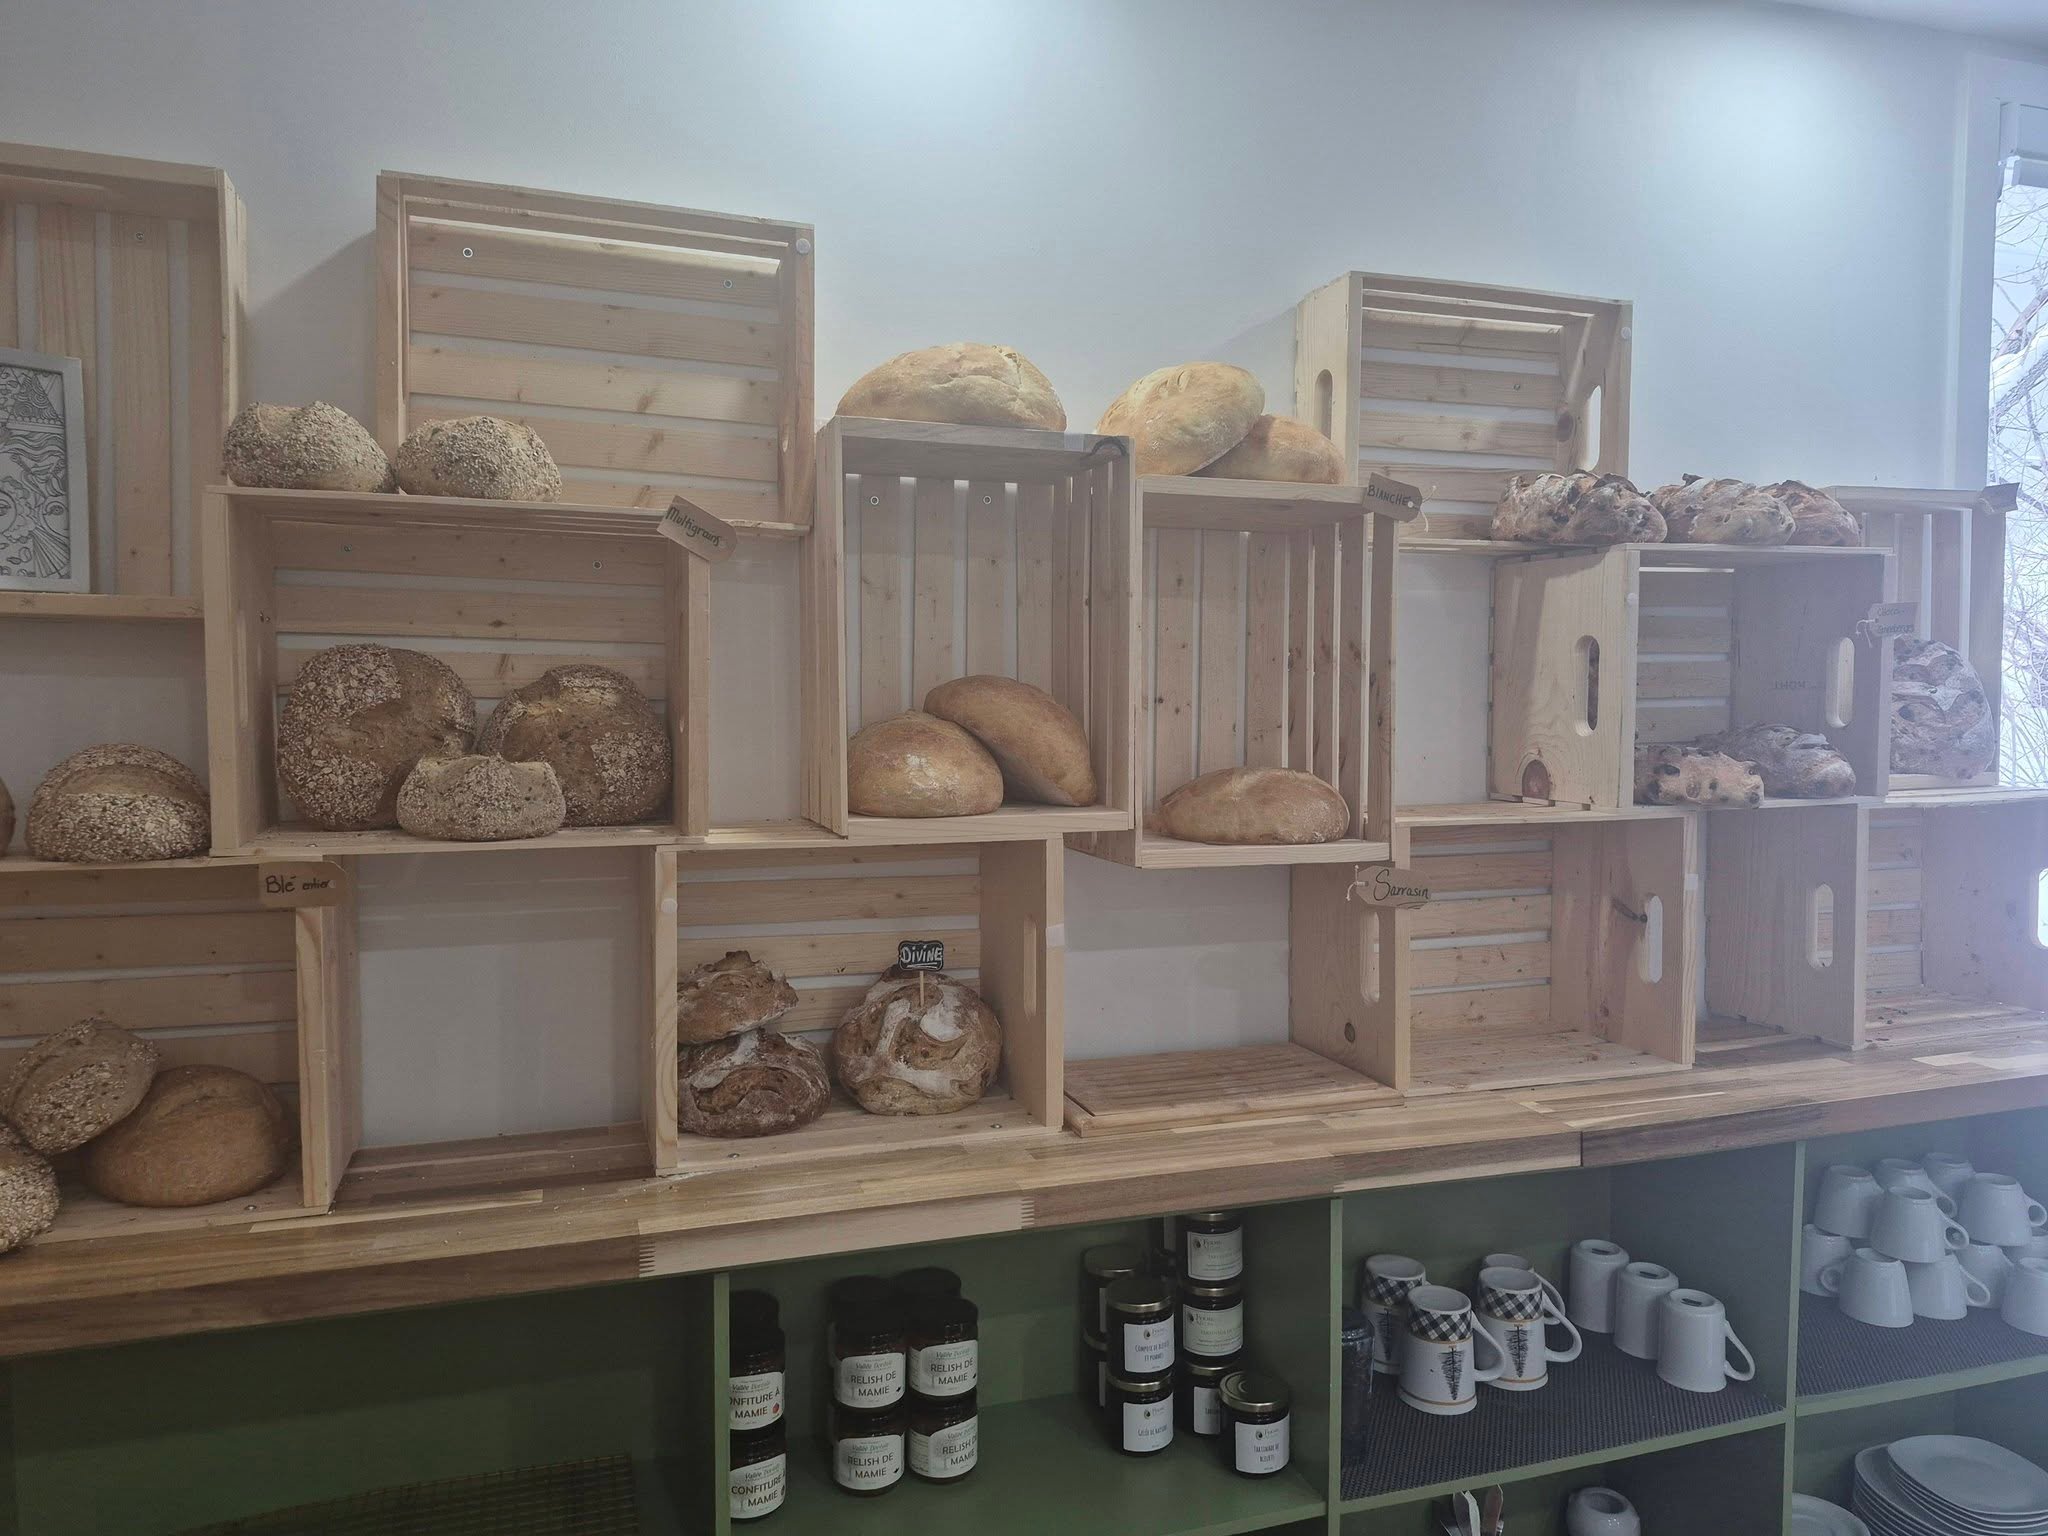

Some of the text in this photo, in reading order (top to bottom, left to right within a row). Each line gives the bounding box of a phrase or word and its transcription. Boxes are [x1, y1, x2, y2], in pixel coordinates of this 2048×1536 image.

[265, 874, 297, 894] Blé
[1373, 868, 1429, 902] Sarrasin
[930, 1357, 974, 1373] RELISH DE
[850, 1370, 897, 1385] RELISH DE
[938, 1372, 968, 1385] MAMIE
[858, 1385, 890, 1397] MAMIE
[735, 1406, 768, 1419] MAMIE
[942, 1438, 971, 1455] RELISH
[847, 1452, 894, 1467] RELISH DE
[855, 1466, 887, 1479] MAMIE
[731, 1473, 782, 1495] CONFITURE
[747, 1489, 779, 1507] MAMIE
